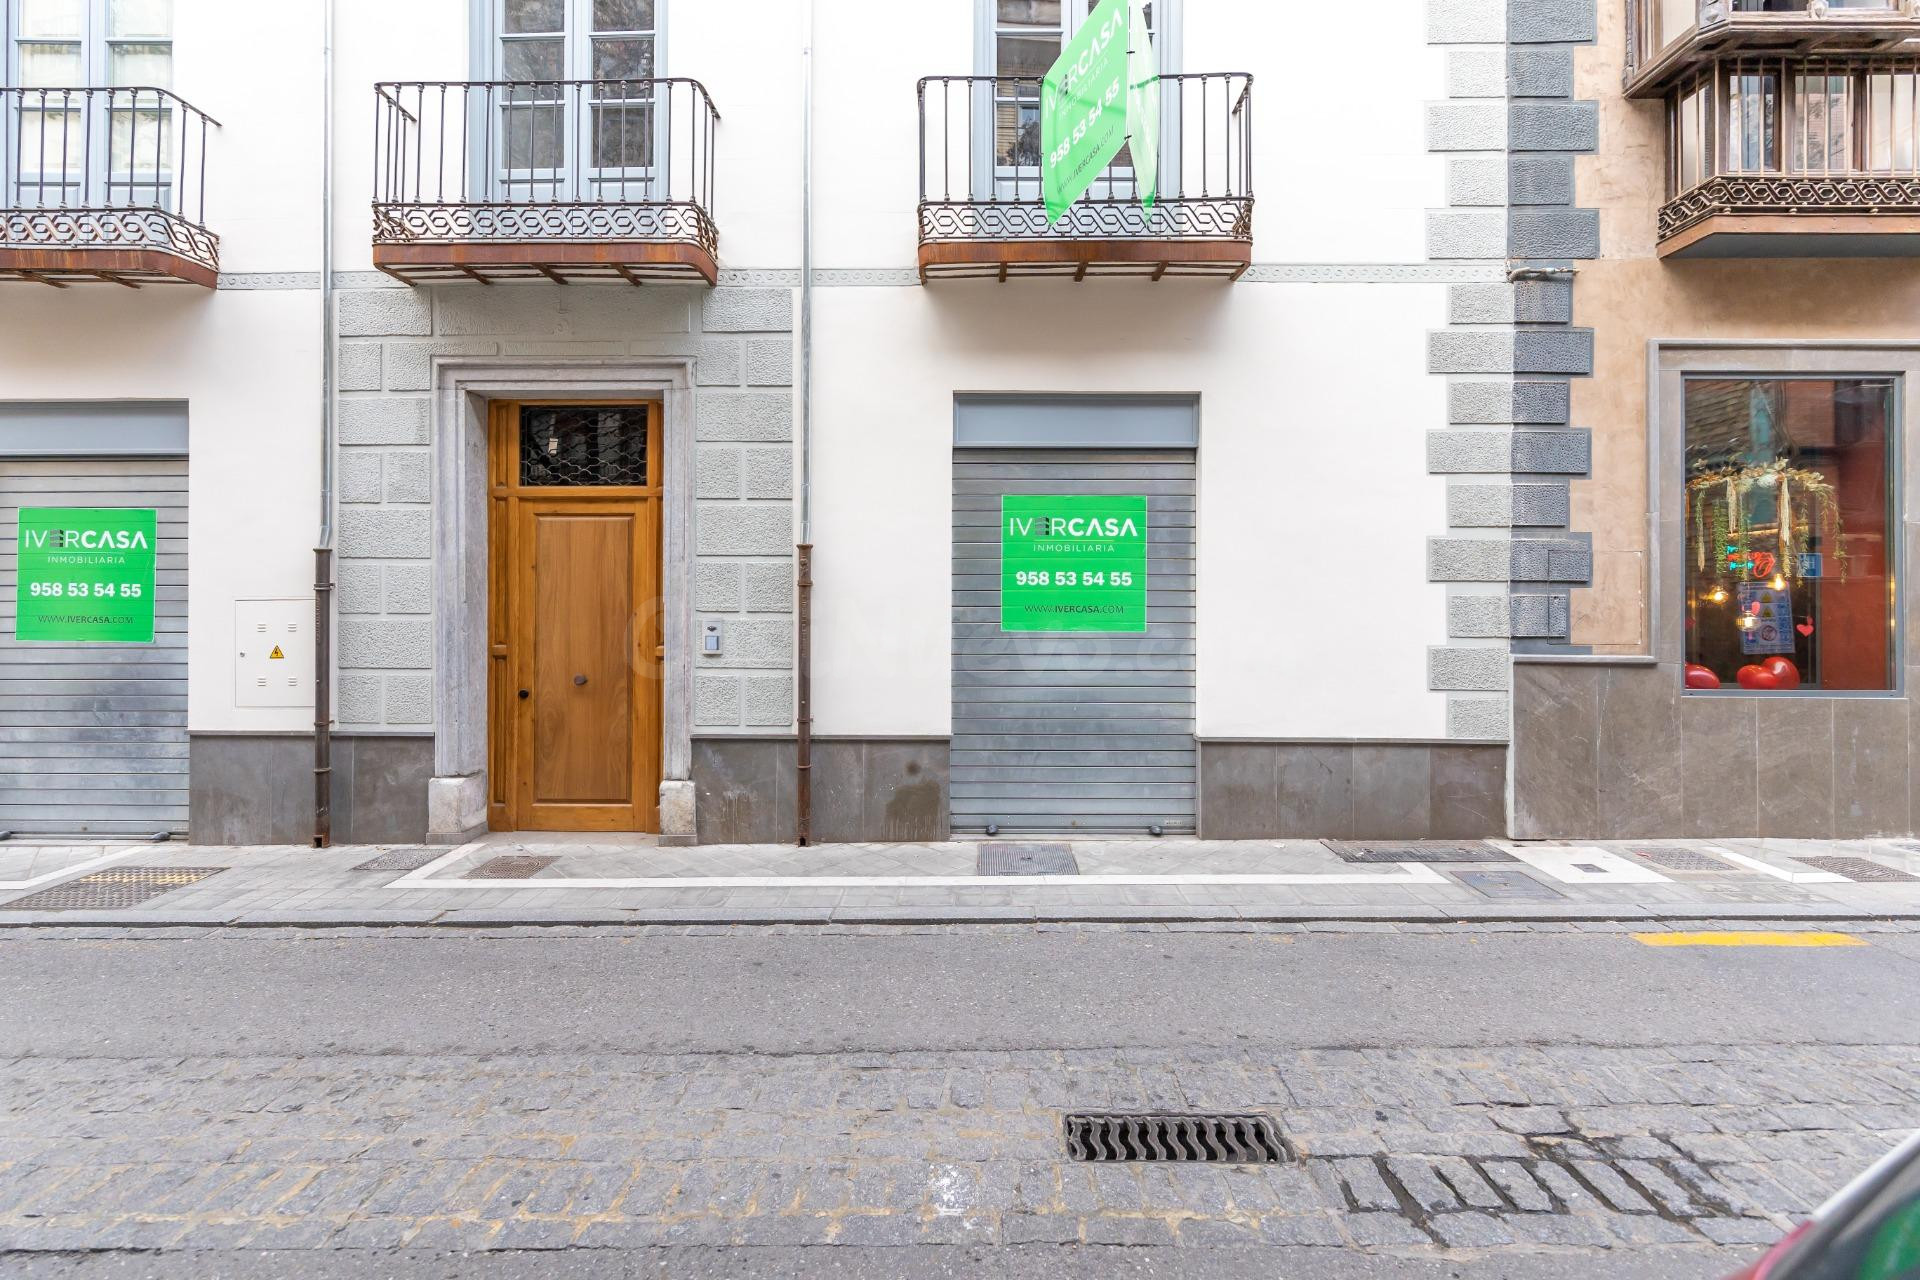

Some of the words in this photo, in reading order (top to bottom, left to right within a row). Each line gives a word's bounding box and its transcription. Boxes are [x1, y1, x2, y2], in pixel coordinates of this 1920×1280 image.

[1050, 137, 1070, 168] 958
[1073, 119, 1086, 144] 53
[1088, 98, 1103, 127] 54
[1105, 76, 1119, 106] 55
[1009, 516, 1138, 537] IVERCASA
[25, 529, 148, 549] IVERCASA
[1033, 544, 1115, 553] INMOBILIARIA
[48, 556, 126, 564] INMOBILIARIA
[1015, 571, 1050, 586] 958
[1054, 571, 1077, 586] 53
[1082, 571, 1105, 586] 54
[1109, 571, 1133, 586] 55
[30, 582, 63, 597] 958
[67, 582, 89, 597] 53
[93, 583, 115, 598] 54
[120, 583, 142, 598] 55
[1024, 605, 1124, 614] WWW.IVERCASA.COM
[38, 615, 134, 624] WWW.IVERCASA.COM
